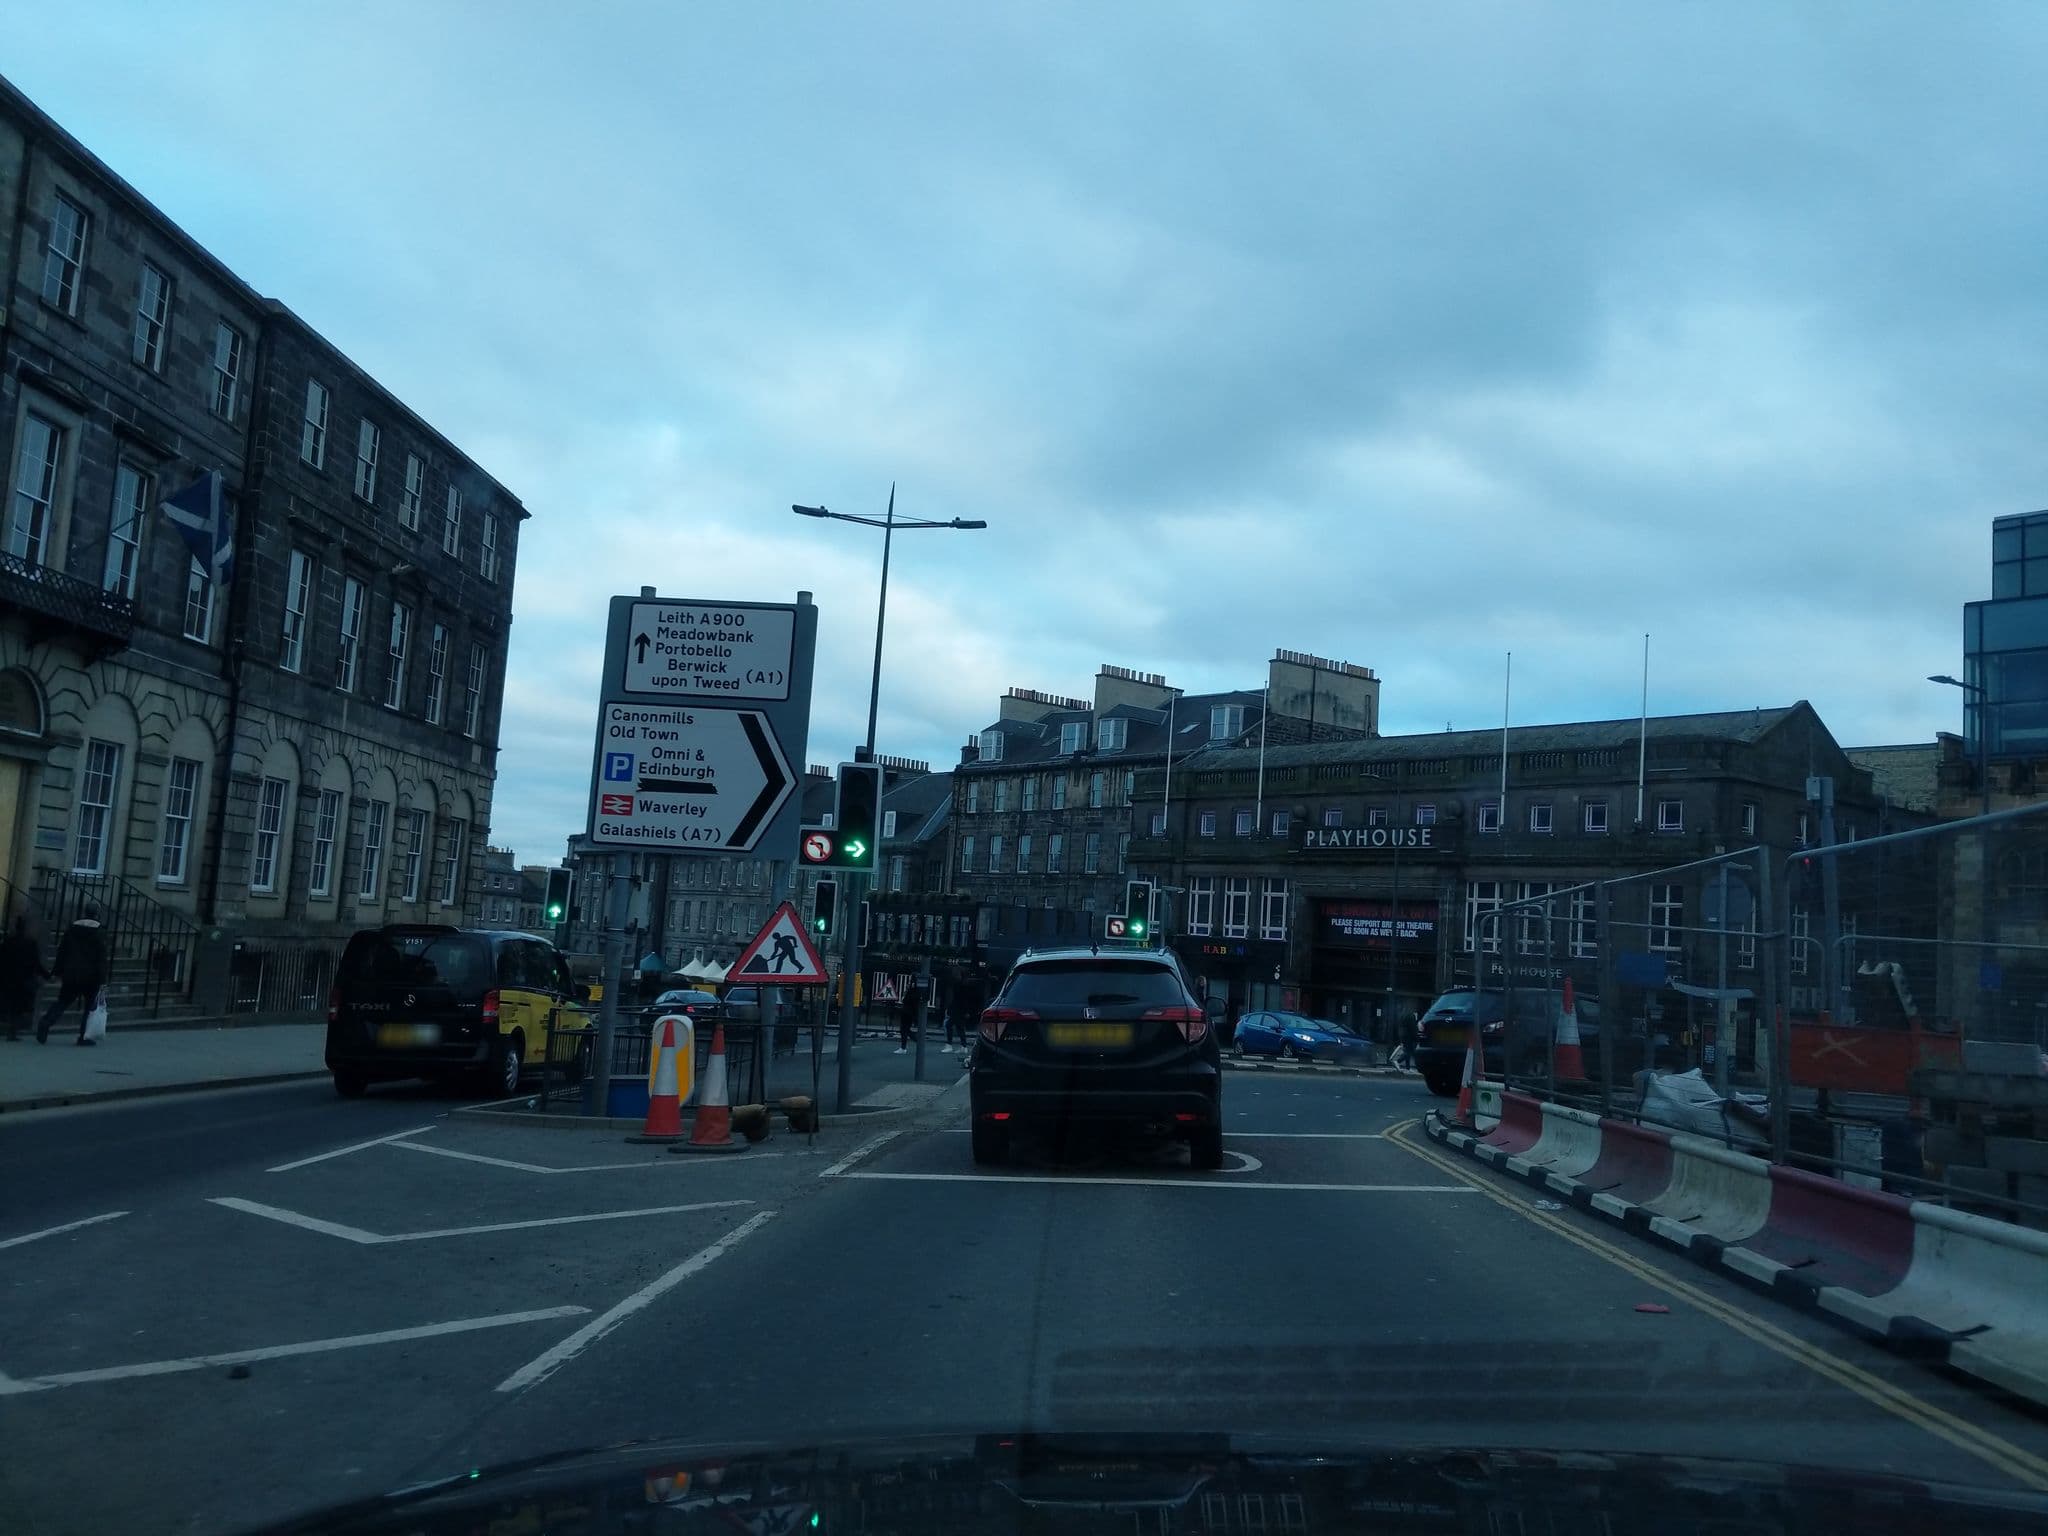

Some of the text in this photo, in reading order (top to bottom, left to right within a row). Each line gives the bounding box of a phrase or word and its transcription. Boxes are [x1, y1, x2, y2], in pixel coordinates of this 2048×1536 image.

[658, 611, 745, 627] Leith A900
[657, 627, 754, 643] Meadowbank
[655, 643, 732, 658] Portobello
[668, 659, 727, 673] Berwick
[652, 676, 740, 690] upon Tweed
[746, 669, 784, 686] (A1)
[611, 709, 694, 725] Canonmills
[610, 725, 679, 741] Old Town
[651, 746, 705, 761] Omni &
[611, 756, 630, 778] P
[639, 762, 715, 779] Edinburgh
[639, 800, 708, 817] Waverley
[600, 823, 721, 843] Galashiels (A7)
[1306, 828, 1432, 847] PLAYHOUSE
[1331, 918, 1434, 931] PLEASE SUPPORT BRITSH THEATRE
[1343, 927, 1352, 935] AS
[1353, 927, 1369, 936] SOON
[1370, 928, 1378, 936] AS
[1491, 963, 1563, 979] PLAHOUSE
